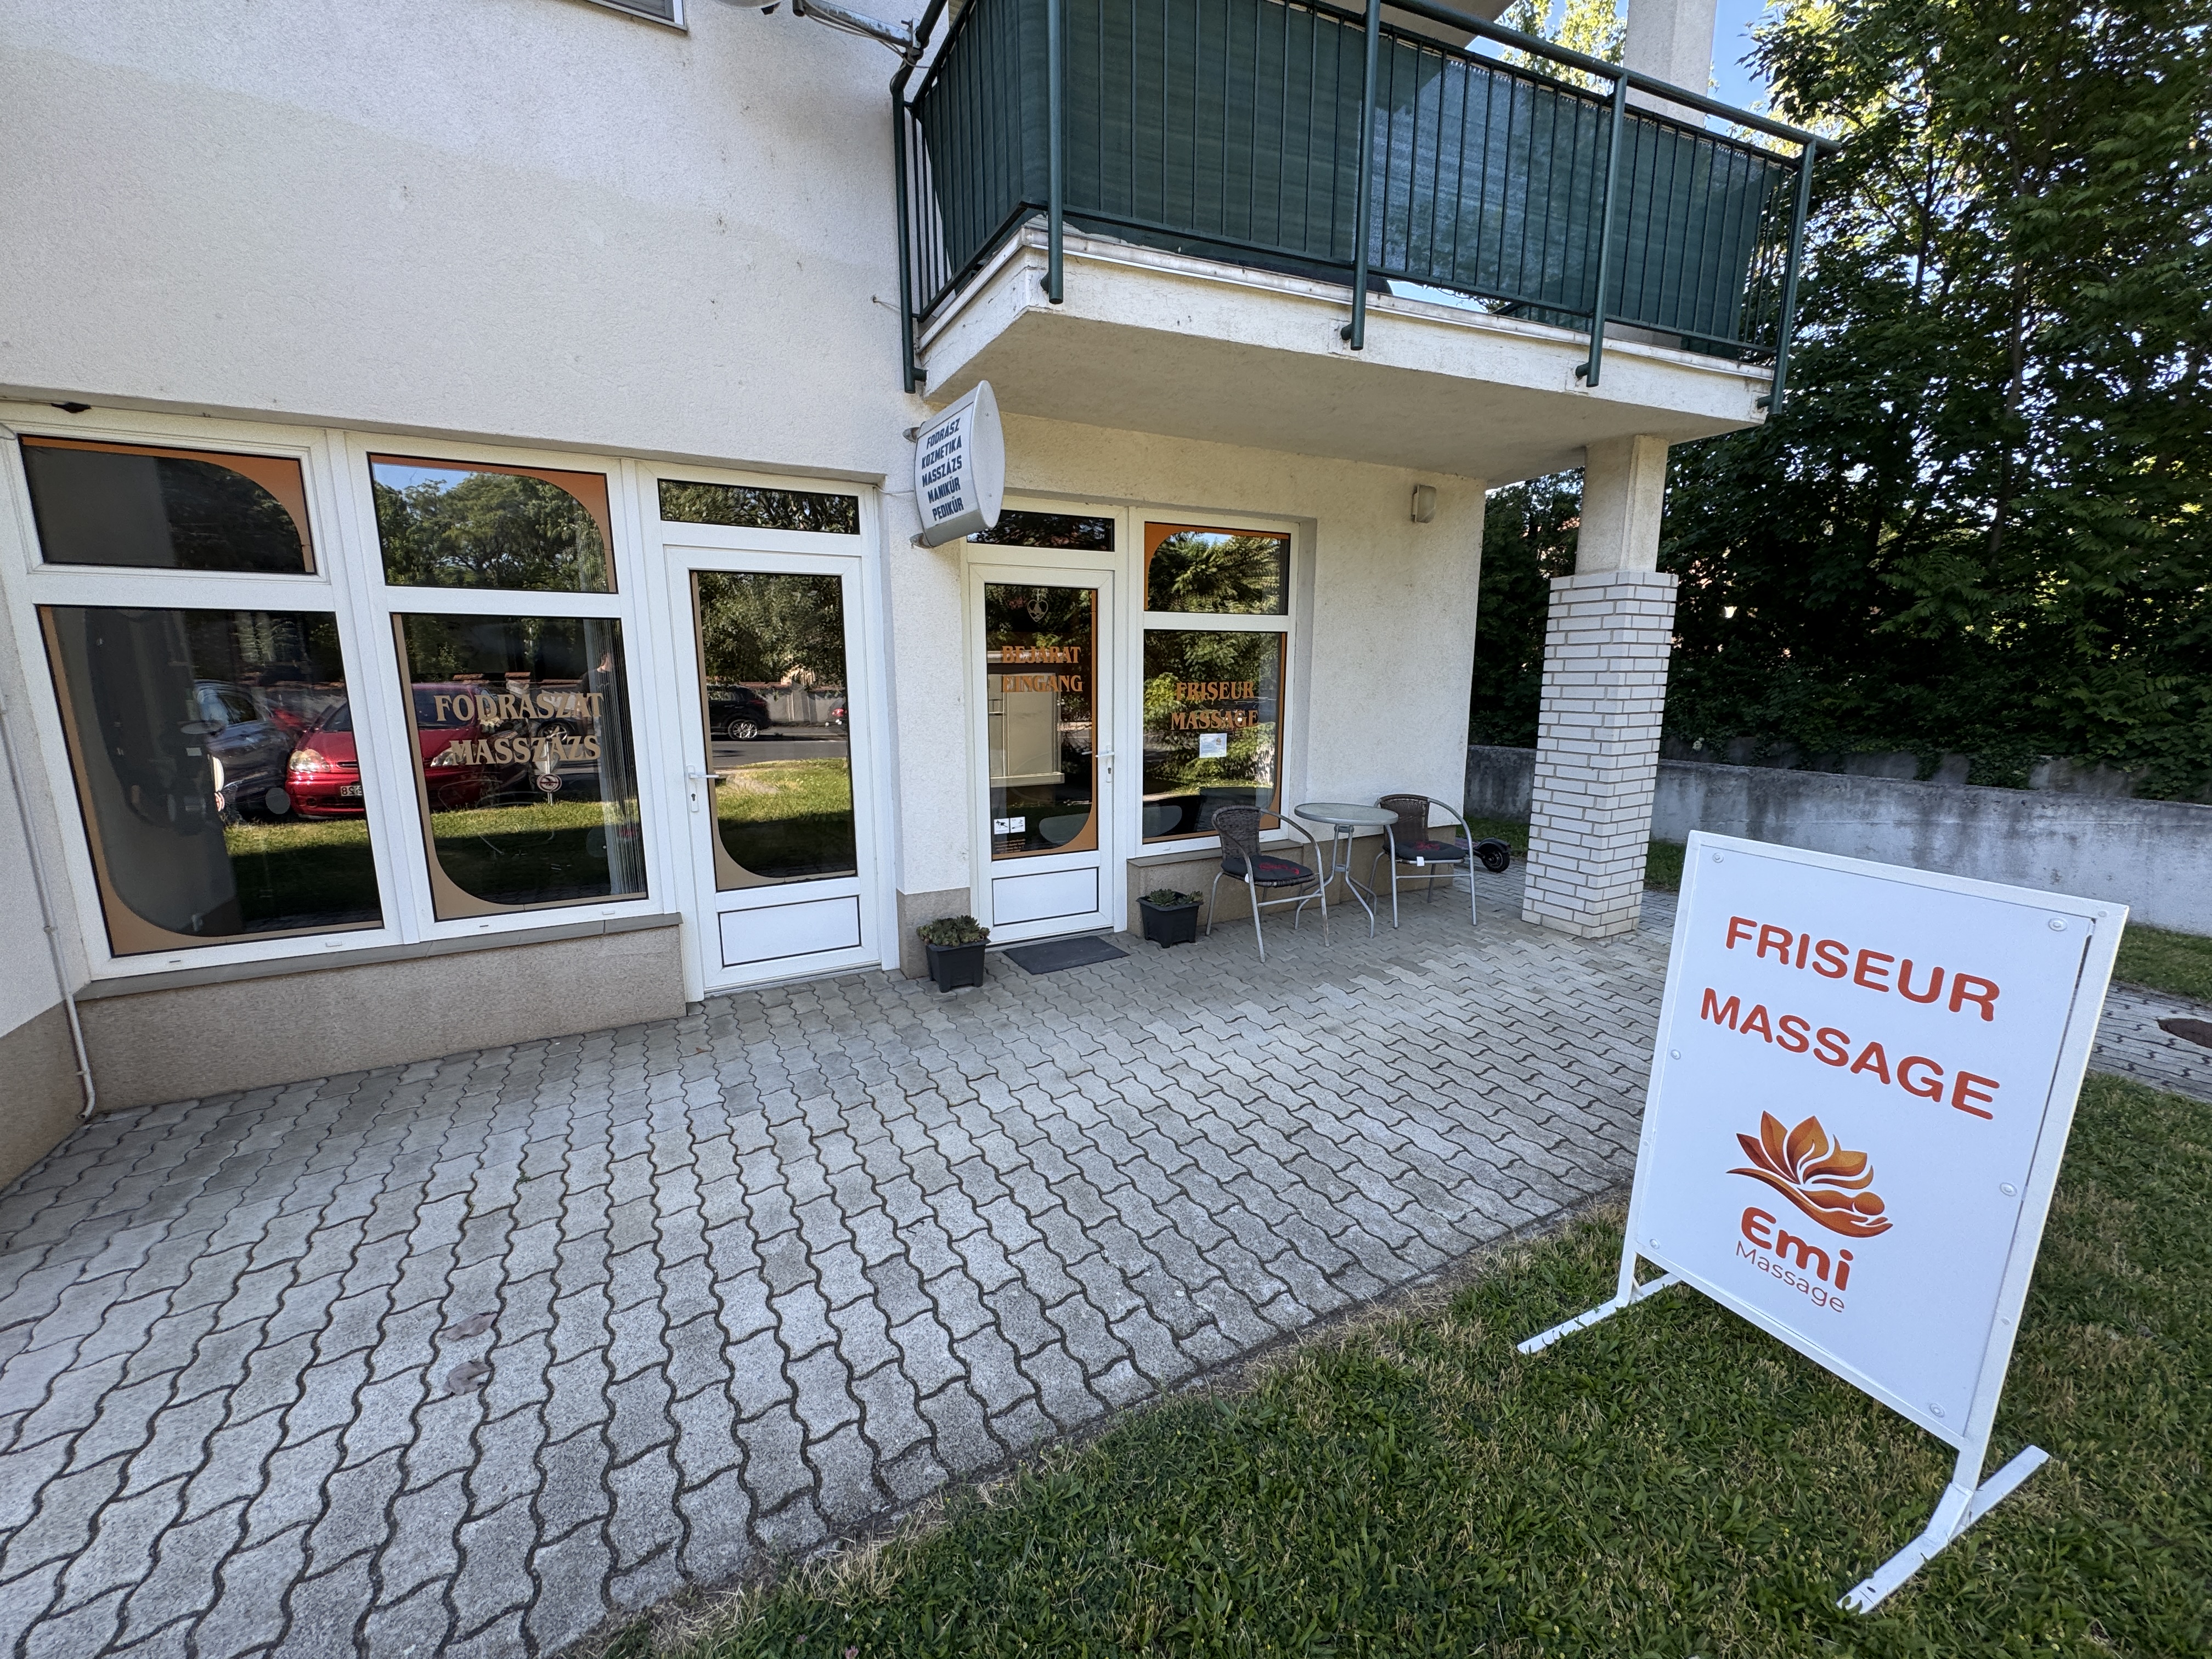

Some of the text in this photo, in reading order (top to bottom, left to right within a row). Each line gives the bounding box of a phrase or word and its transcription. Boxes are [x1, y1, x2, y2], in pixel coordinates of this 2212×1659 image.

[926, 417, 961, 450] FODRÁSZ
[922, 436, 962, 470] KOZMETIKA
[922, 455, 962, 487] MASSZÁZS
[1003, 675, 1083, 692] EINGANG
[1176, 681, 1255, 701] FRISEUR
[1171, 710, 1259, 730] MASSAGE
[1725, 916, 2000, 1022] FRISEUR
[1701, 988, 2000, 1120] MASSAGE
[1741, 1207, 1854, 1291] Emi
[1736, 1240, 1846, 1313] Massage
